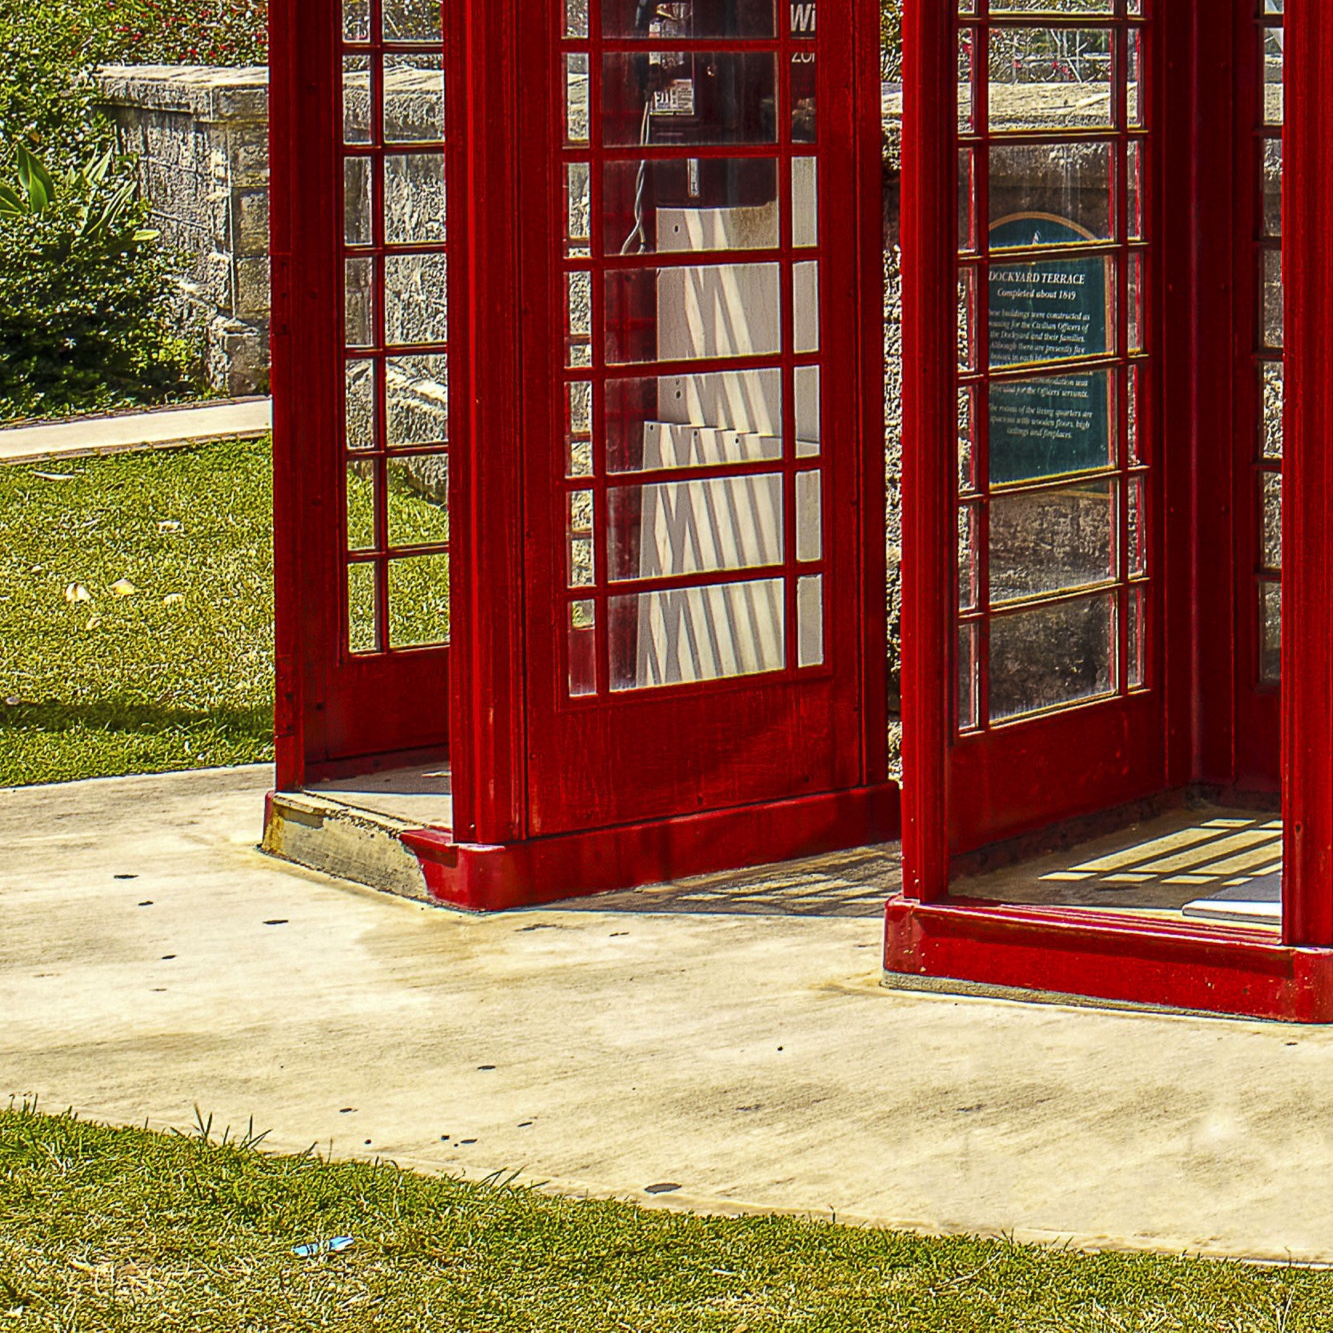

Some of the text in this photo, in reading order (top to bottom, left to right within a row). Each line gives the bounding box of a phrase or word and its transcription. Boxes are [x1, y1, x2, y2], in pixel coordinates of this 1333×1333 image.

[790, 3, 816, 32] Wi
[988, 271, 1086, 284] DOCKYARD TERRACE
[997, 288, 1034, 300] Completed
[1036, 289, 1056, 298] about
